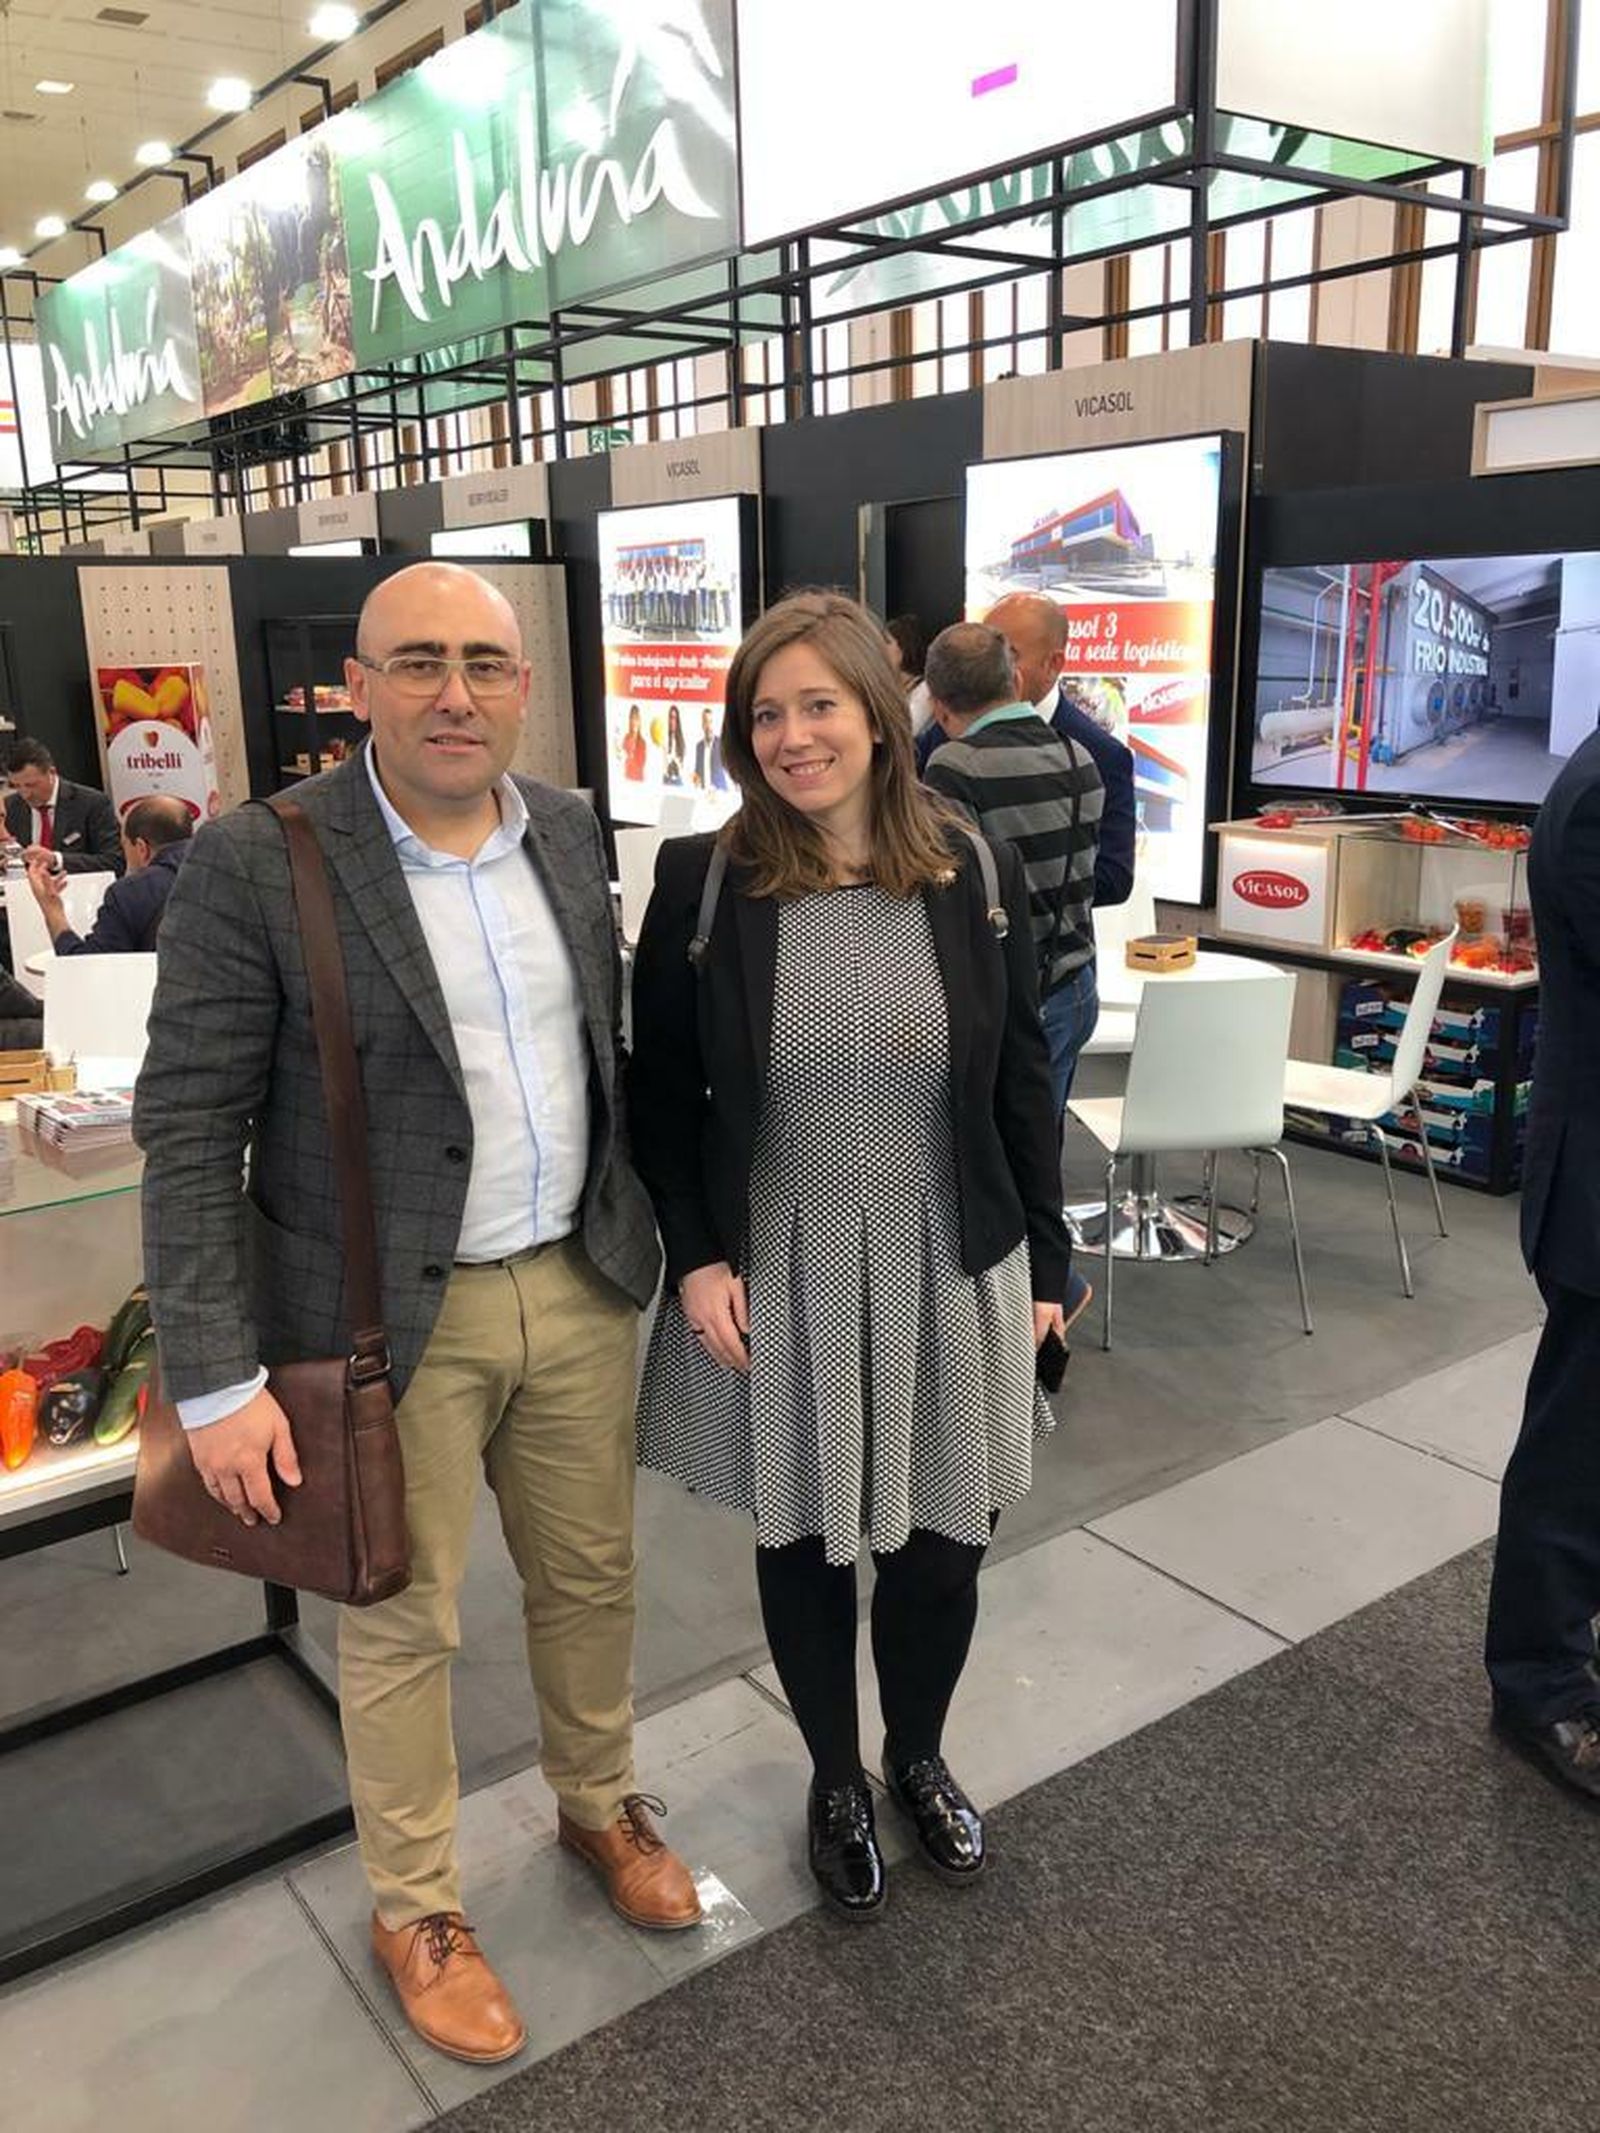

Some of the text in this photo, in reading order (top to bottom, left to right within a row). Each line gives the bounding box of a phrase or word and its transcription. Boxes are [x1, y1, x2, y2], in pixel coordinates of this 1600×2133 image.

[1074, 391, 1134, 417] VICASOL
[1068, 612, 1118, 639] asol 3
[1084, 640, 1119, 662] sede
[1123, 637, 1198, 668] logístic
[127, 752, 183, 769] tribelli
